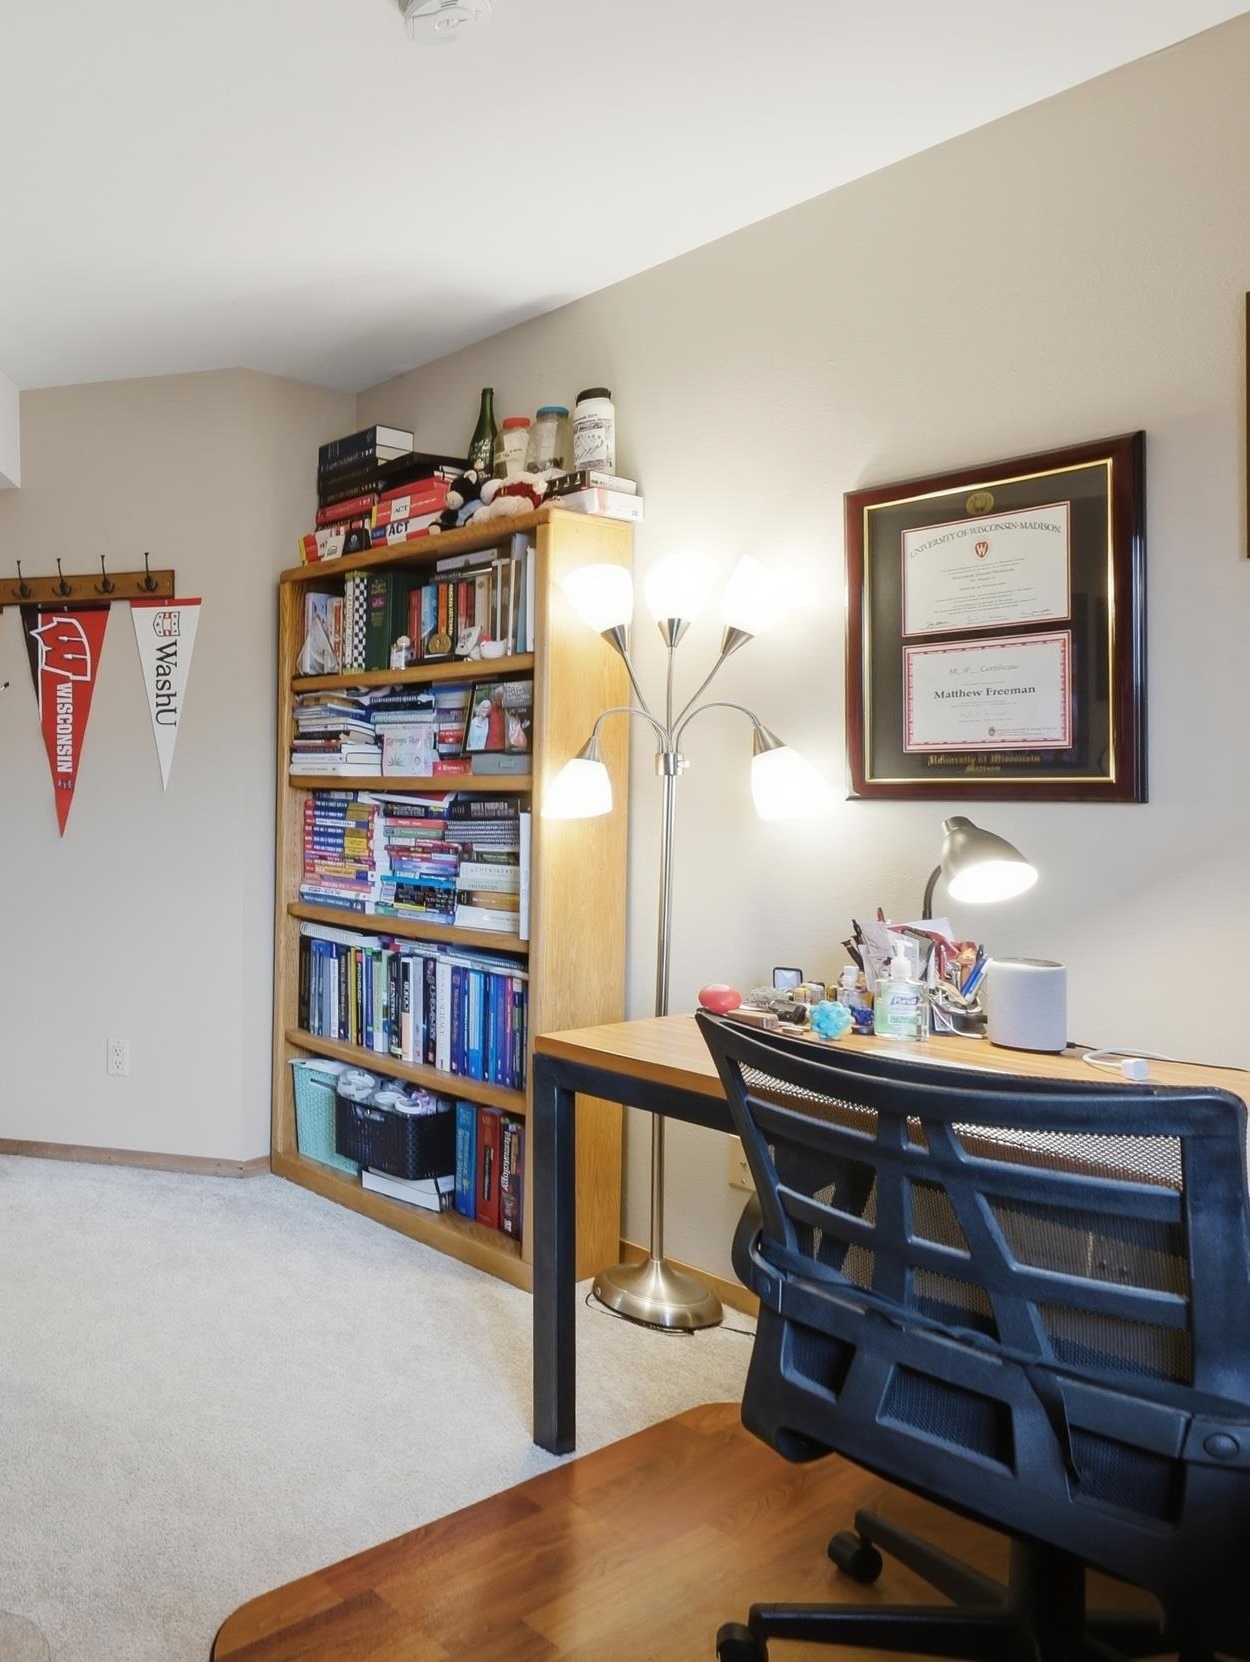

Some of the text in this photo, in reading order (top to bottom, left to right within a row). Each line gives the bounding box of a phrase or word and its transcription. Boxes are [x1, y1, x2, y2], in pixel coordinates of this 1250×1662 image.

[388, 521, 410, 537] ACT
[910, 532, 956, 558] UNIVERSITY
[957, 528, 969, 538] OF
[154, 638, 178, 728] WashU
[934, 686, 1036, 700] Matthew Freeman
[56, 682, 73, 773] WISCONSIN
[500, 1130, 511, 1192] Hematology
